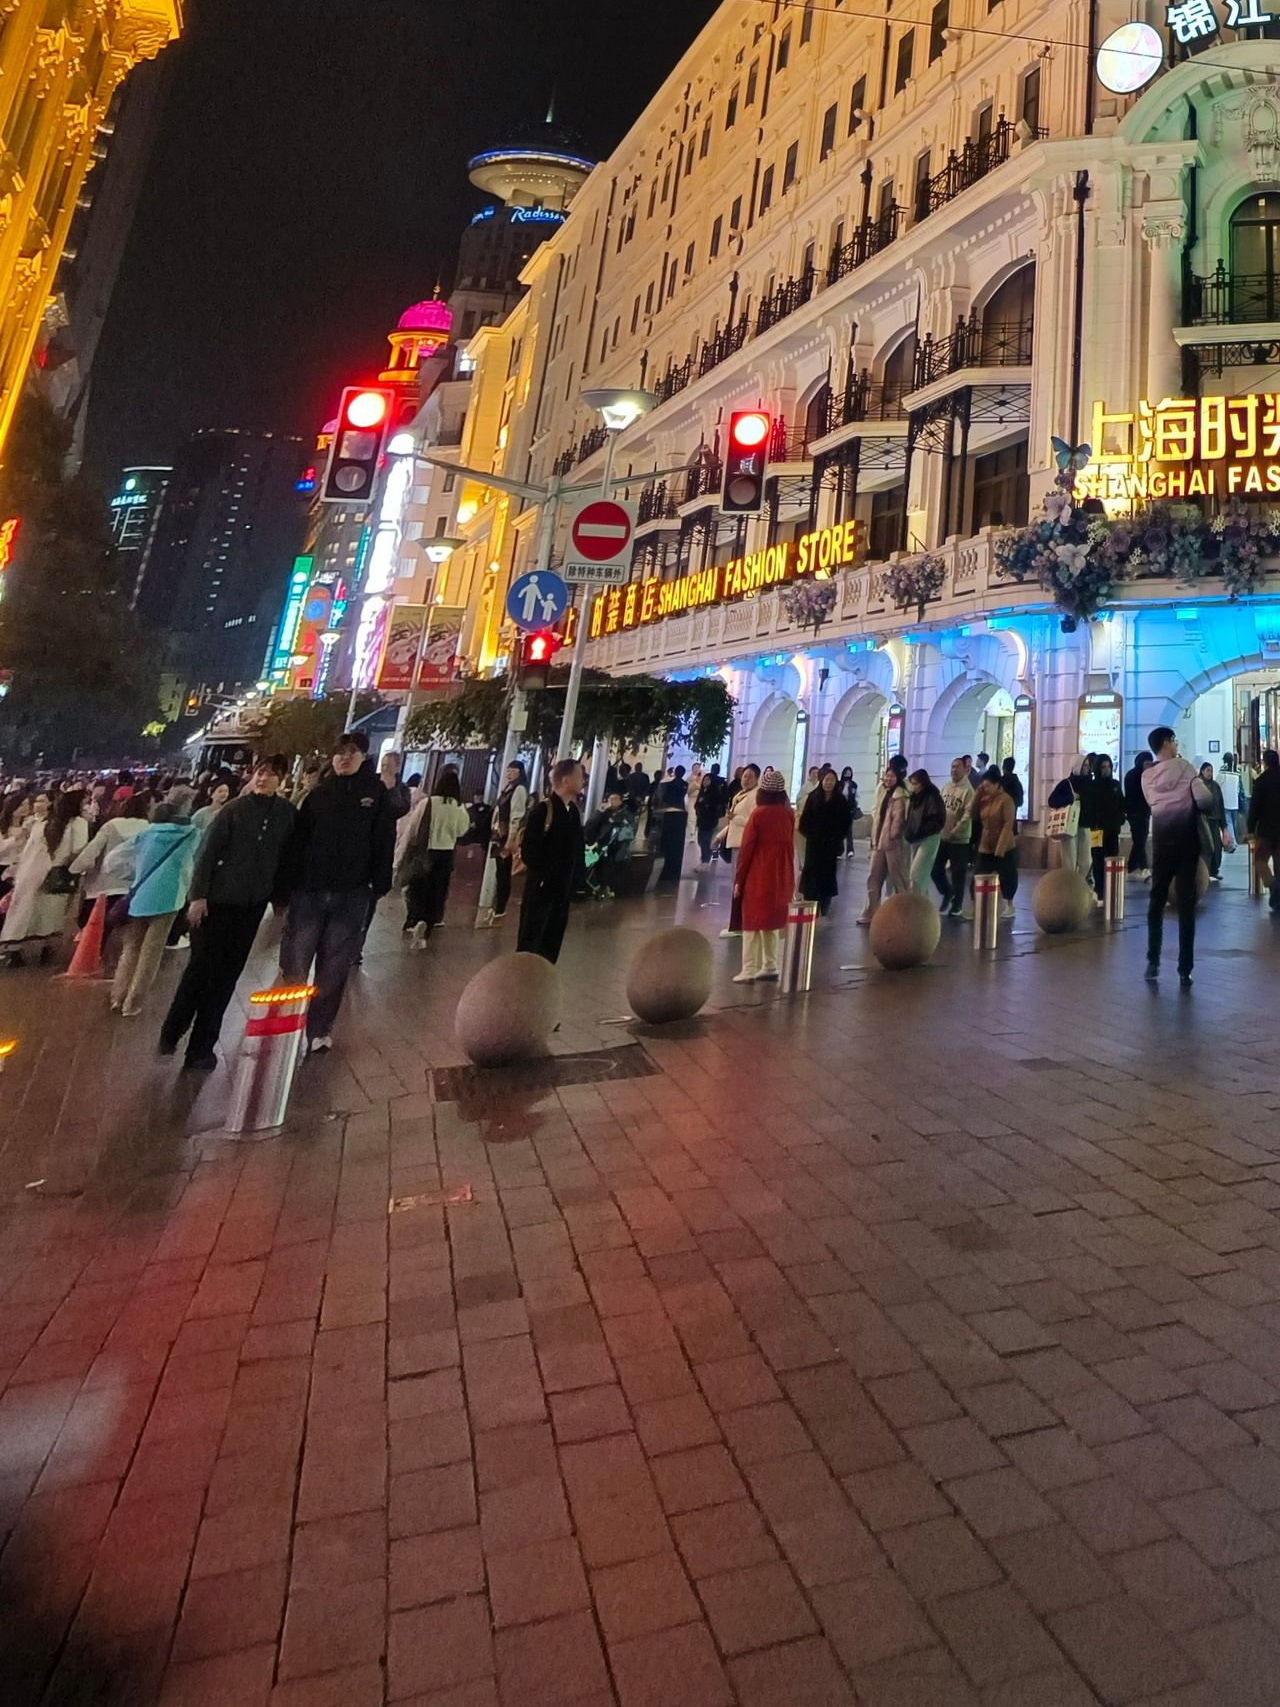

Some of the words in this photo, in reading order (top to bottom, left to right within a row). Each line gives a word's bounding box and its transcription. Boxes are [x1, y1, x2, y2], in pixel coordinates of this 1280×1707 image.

[1072, 468, 1216, 501] SHANGHAI
[567, 564, 623, 581] 除特种车辆外
[658, 567, 718, 615] SHANGHAI
[724, 542, 788, 591] FASHION
[796, 520, 855, 574] STORE
